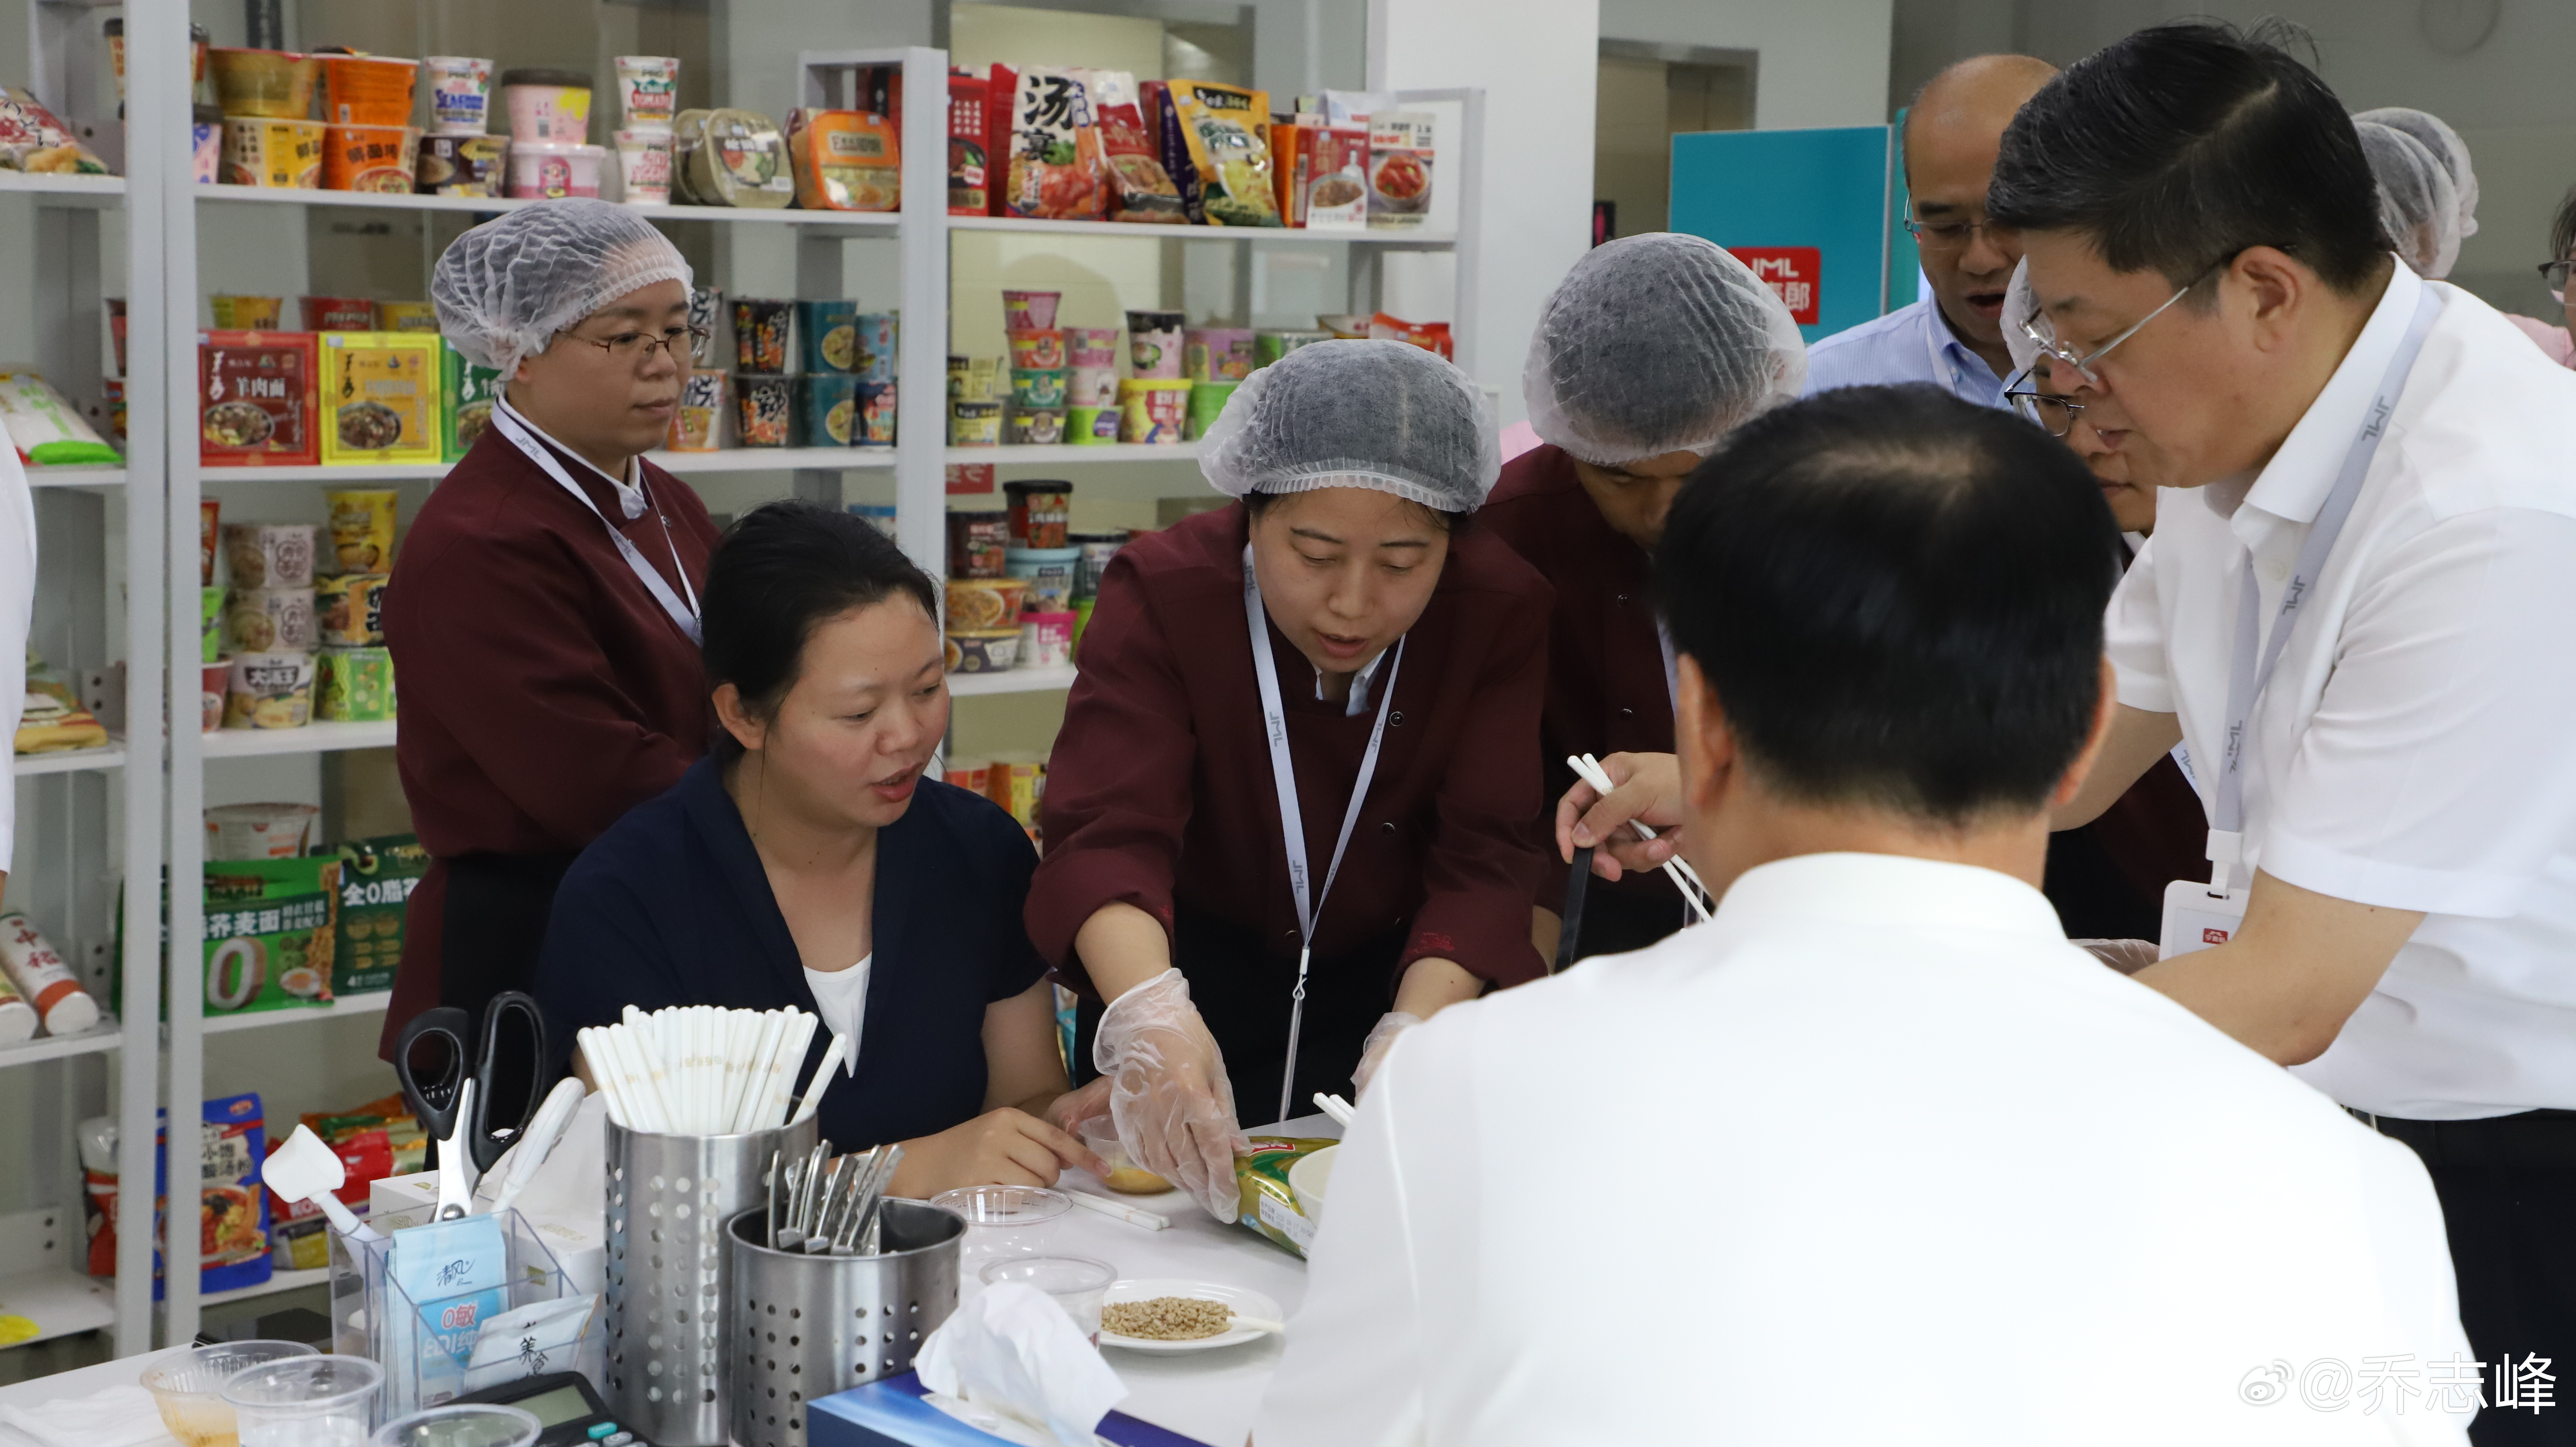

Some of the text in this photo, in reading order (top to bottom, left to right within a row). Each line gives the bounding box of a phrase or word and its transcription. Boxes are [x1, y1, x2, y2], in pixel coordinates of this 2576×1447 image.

[2362, 395, 2391, 444] JML
[516, 437, 540, 459] JML
[2283, 575, 2305, 617] JML
[1269, 711, 1283, 747] JML
[1371, 718, 1383, 753] JML
[1293, 860, 1304, 894] JML
[202, 909, 280, 939] 荞麦面
[436, 1258, 476, 1287] 清风
